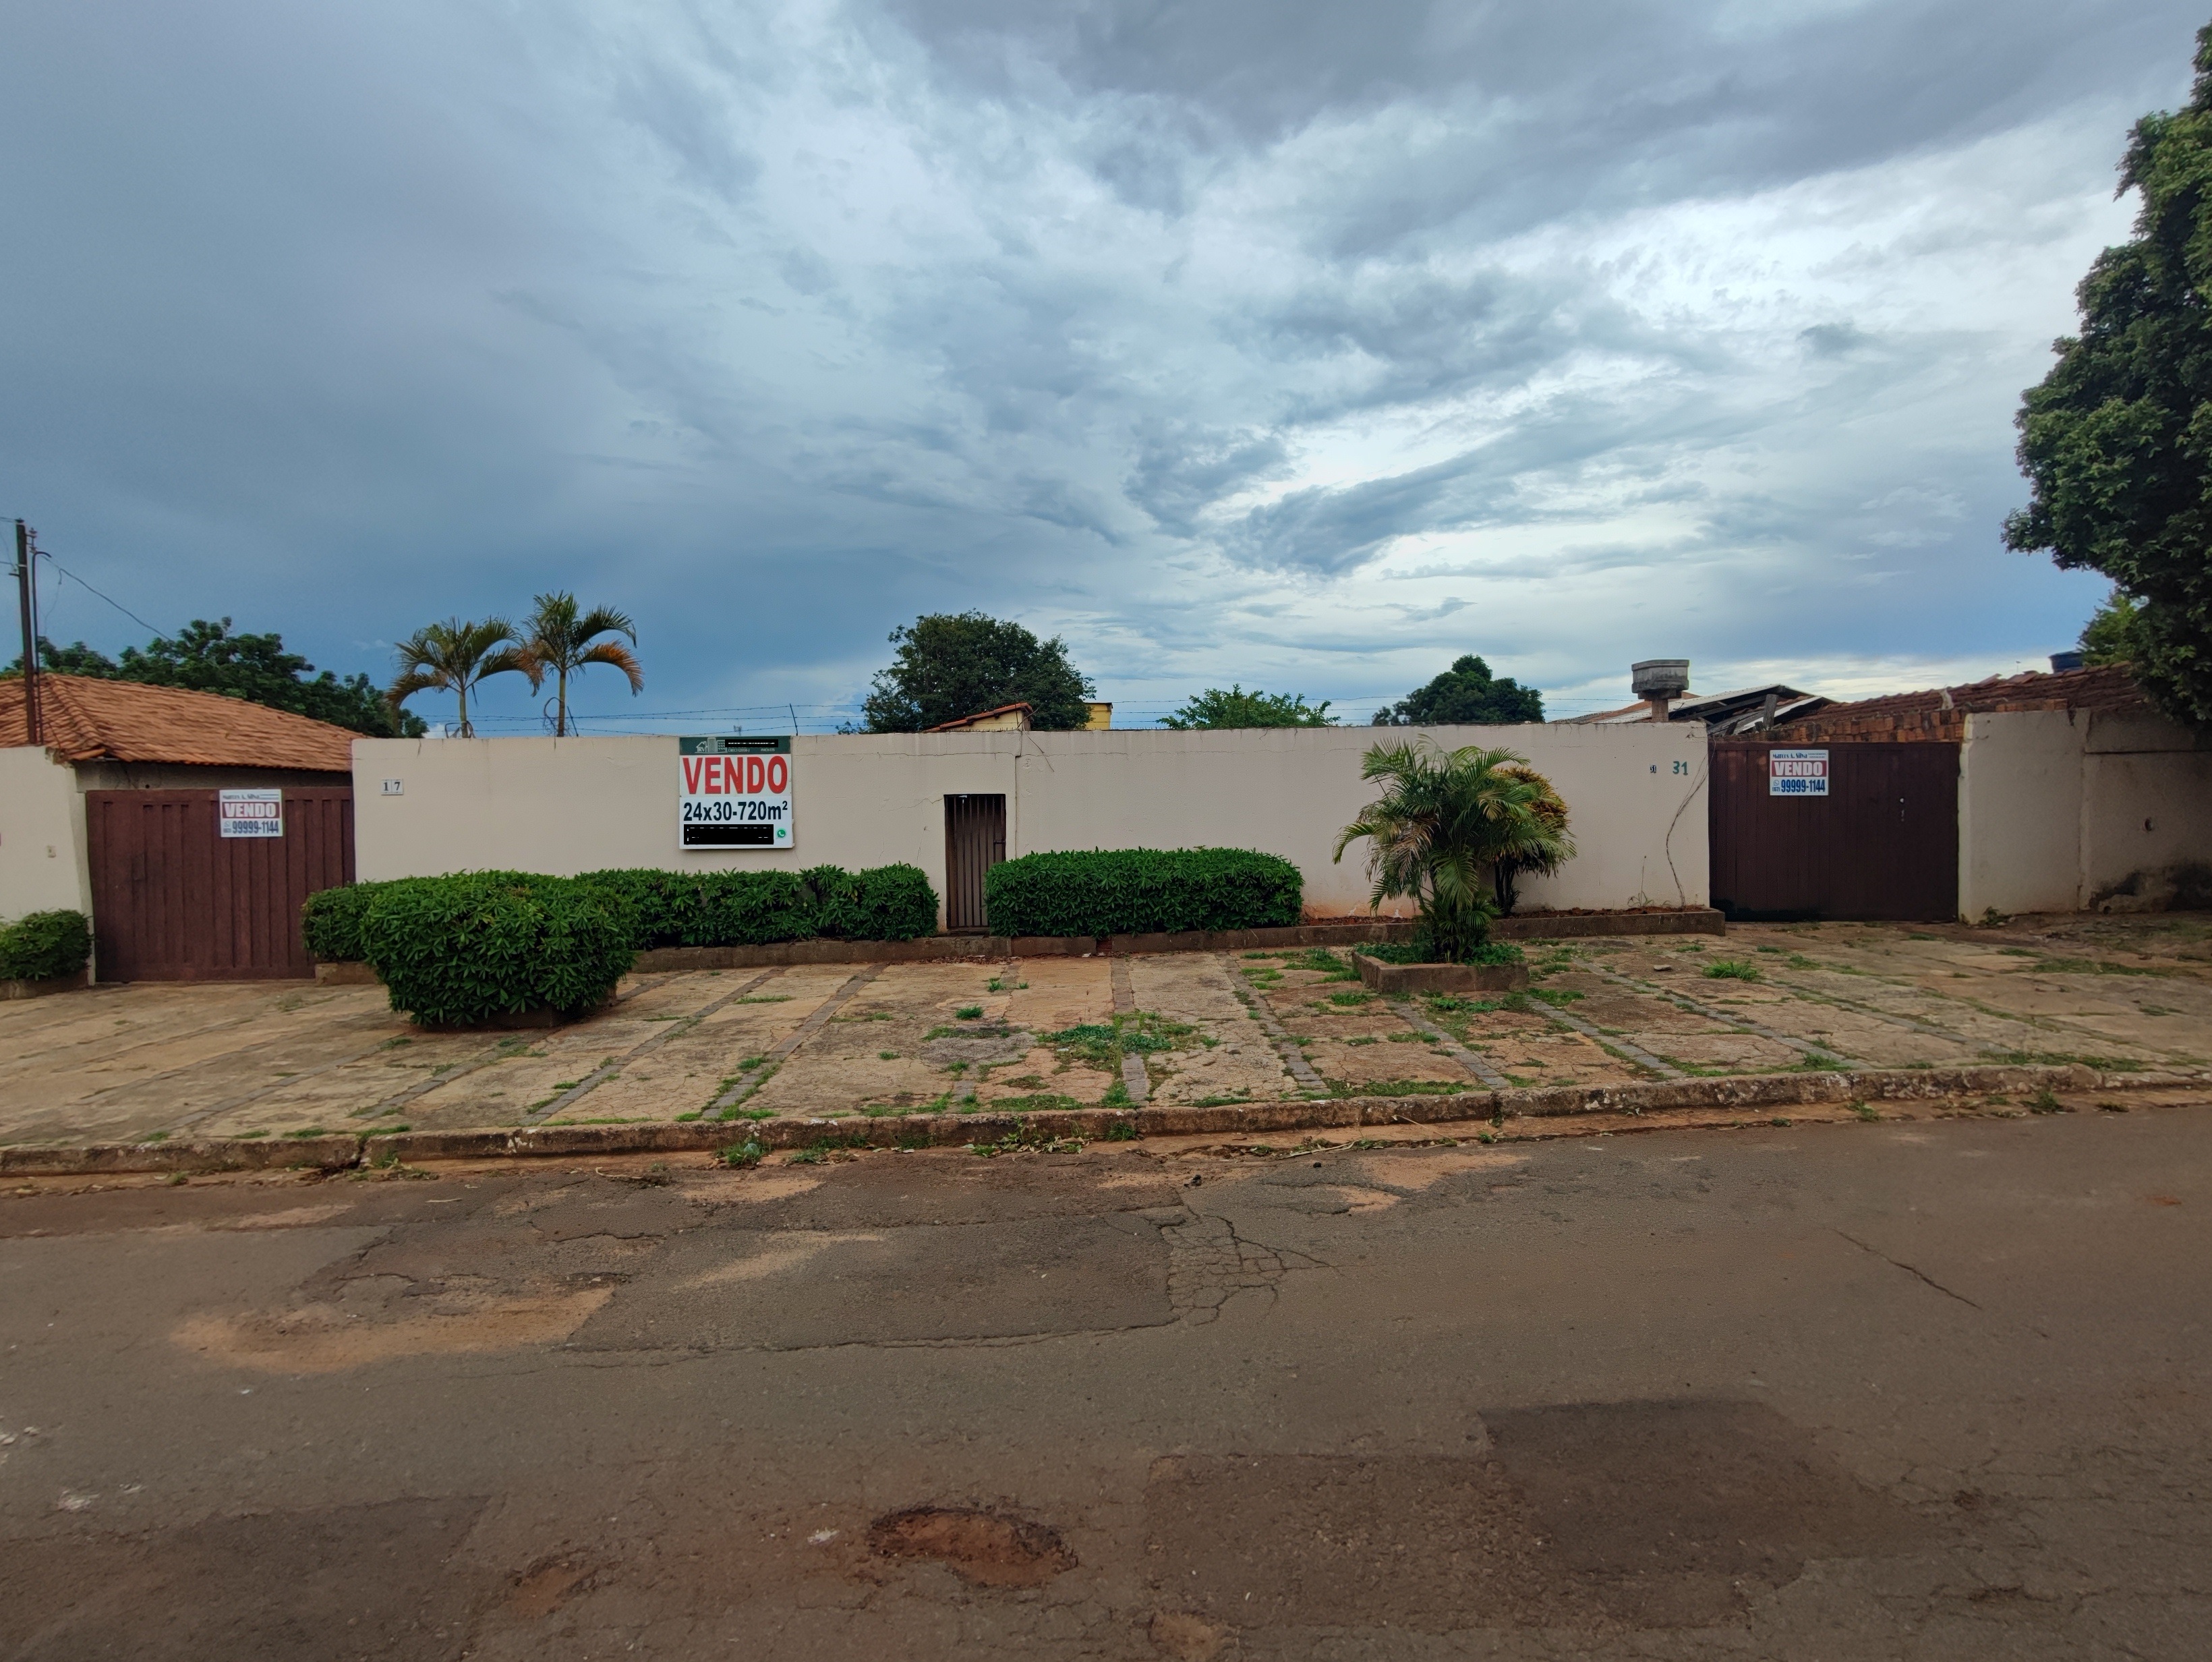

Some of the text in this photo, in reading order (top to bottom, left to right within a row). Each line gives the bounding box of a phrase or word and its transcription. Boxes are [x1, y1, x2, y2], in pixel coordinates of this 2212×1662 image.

[682, 755, 788, 795] VENDO
[1672, 761, 1688, 776] 31
[1774, 762, 1823, 776] VENDO
[1781, 779, 1826, 793] 99999-1144
[224, 803, 276, 818] VENDO
[232, 820, 279, 834] 99999-1144
